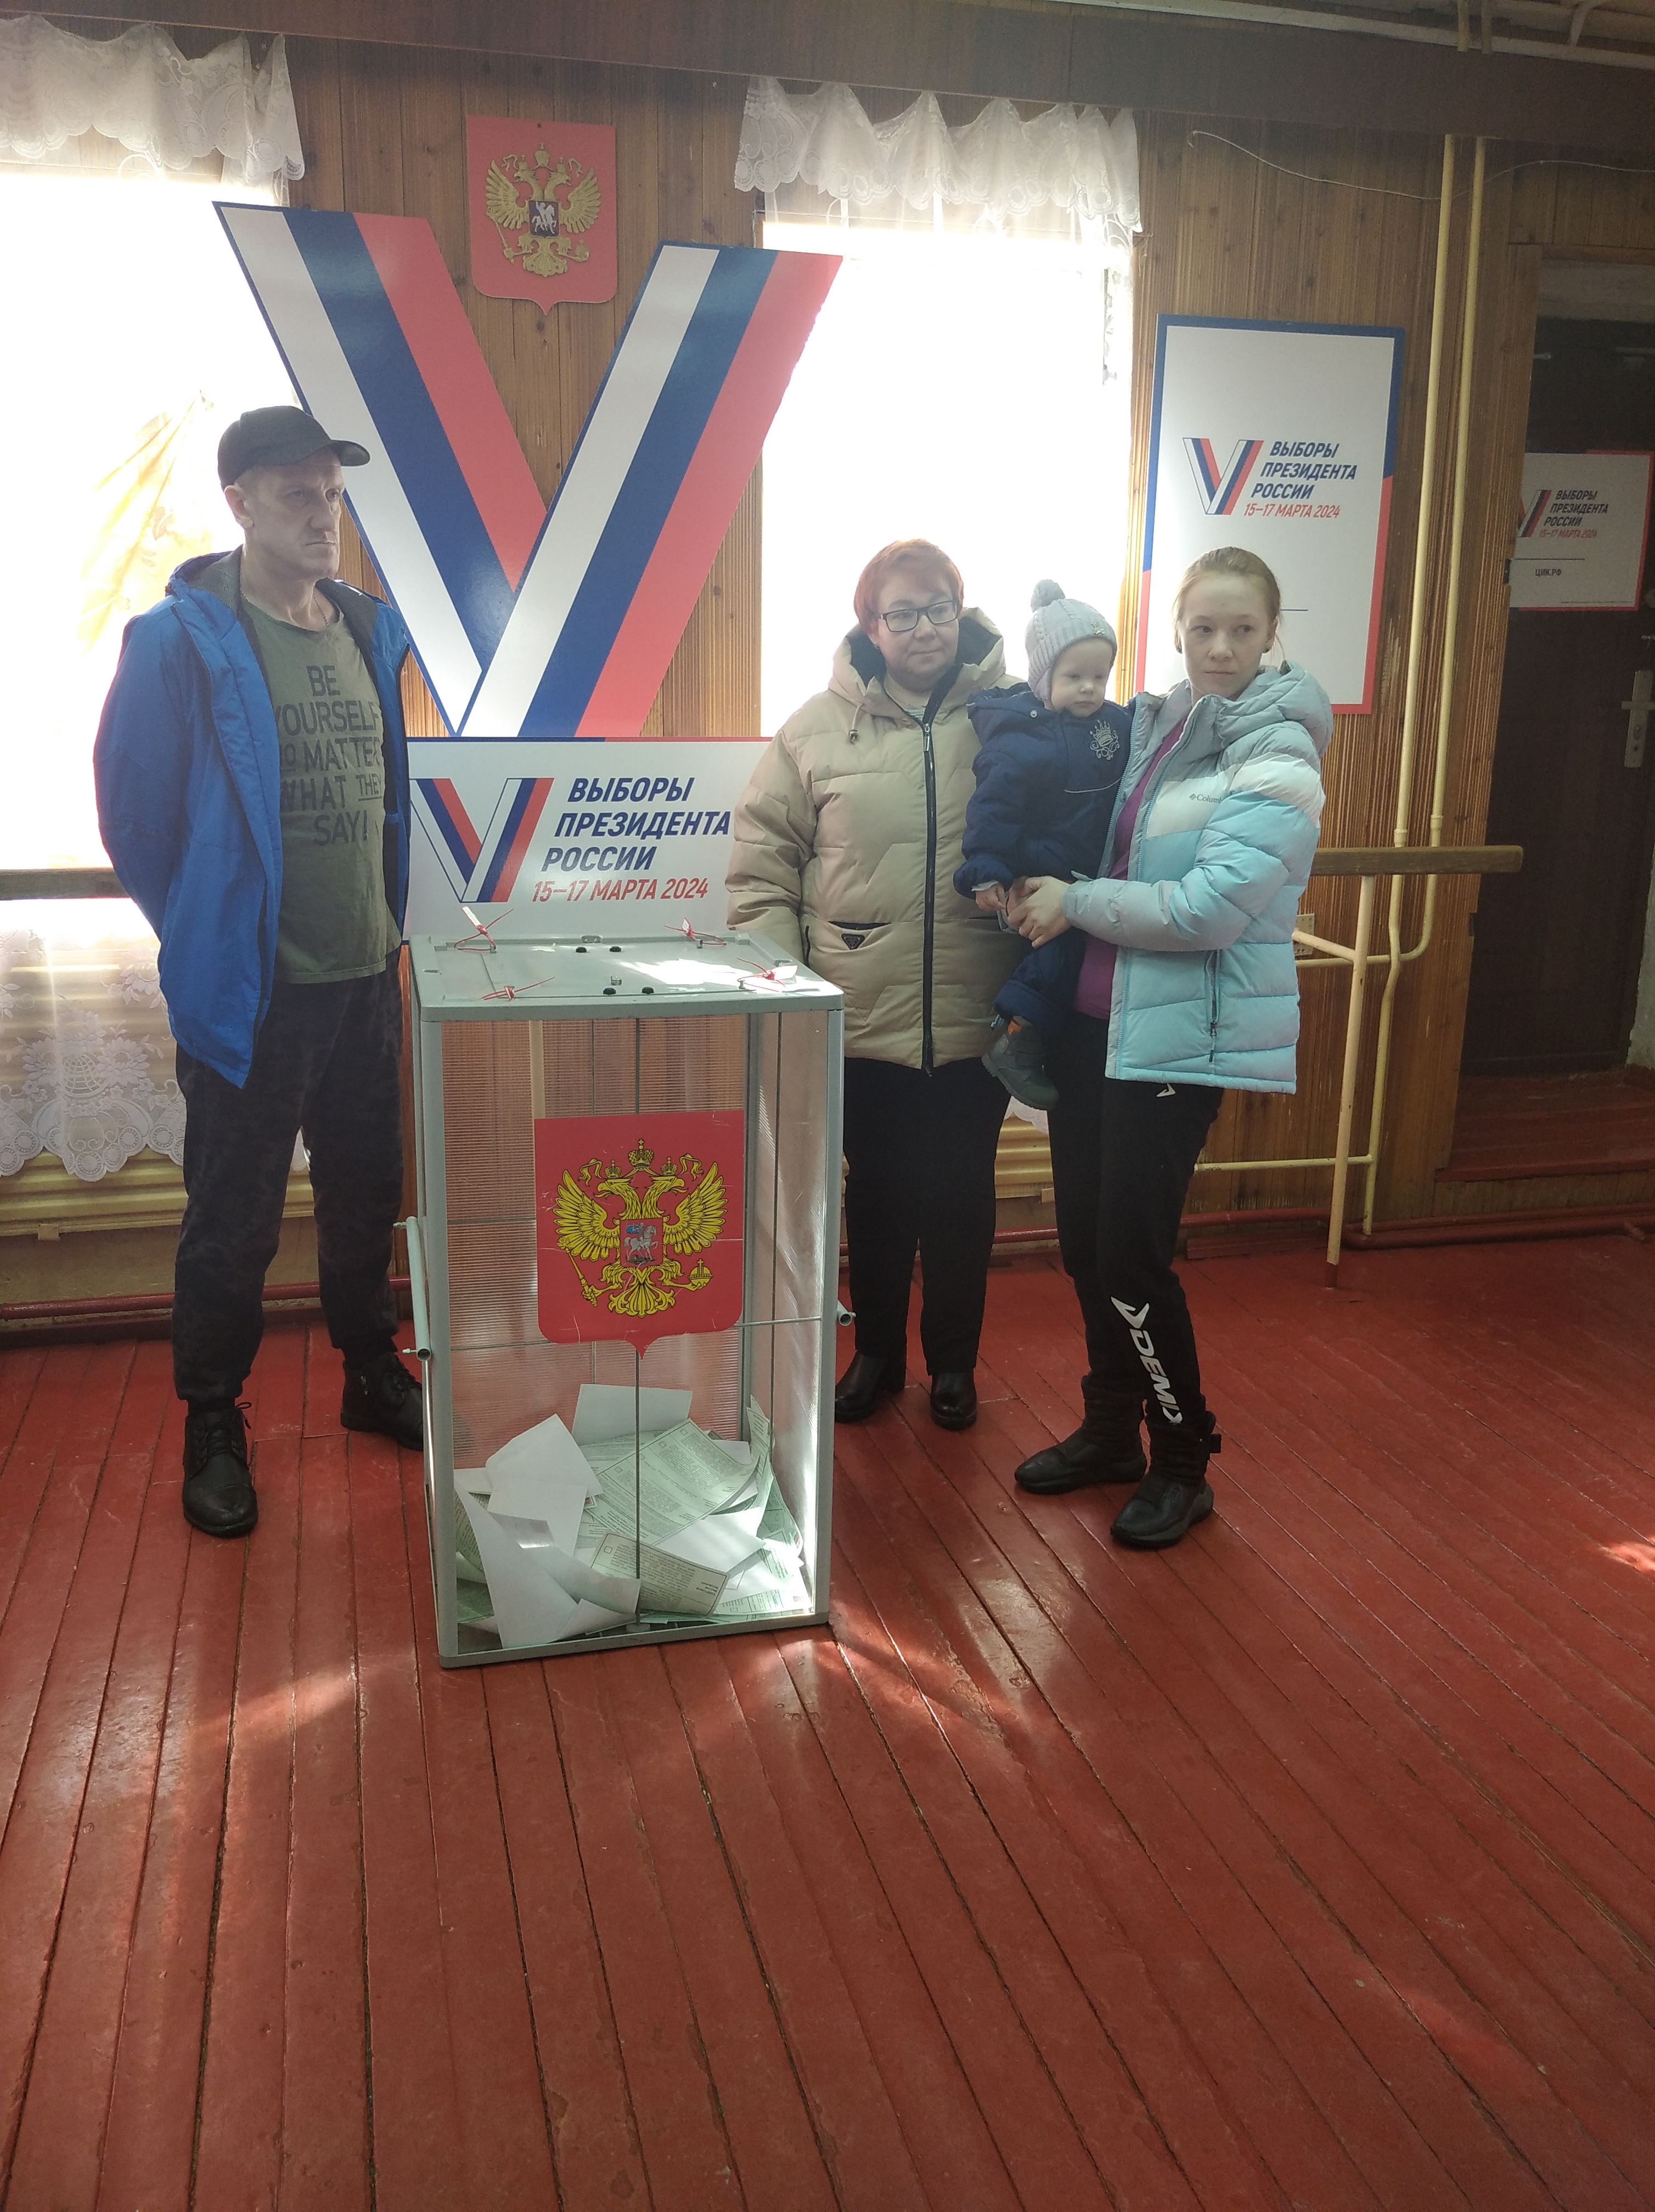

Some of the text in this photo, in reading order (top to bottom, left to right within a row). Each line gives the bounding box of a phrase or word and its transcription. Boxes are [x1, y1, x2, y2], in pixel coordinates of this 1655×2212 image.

[1269, 441, 1340, 458] ВЫБОРЫ
[1260, 462, 1358, 481] ПРЕЗИДЕНТА
[1251, 483, 1315, 499] РОССИИ
[1555, 490, 1598, 500] ВЫБОРЫ
[1274, 504, 1313, 517] МАРТА
[1313, 505, 1341, 518] 2024
[1549, 503, 1609, 515] ПРЕЗИДЕНТА
[1543, 516, 1583, 527] РОССИИ
[1535, 568, 1562, 577] ЦИК.РФ
[306, 664, 341, 697] BE
[303, 736, 380, 773] MATTER
[280, 774, 346, 812] WHAT
[567, 777, 695, 803] ВЫБОРЫ
[1196, 794, 1223, 804] Columb
[554, 811, 731, 840] ПРЕЗИДЕНТА
[541, 845, 658, 872] РОССИИ
[589, 878, 658, 901] МАРТА
[660, 877, 709, 900] 2024
